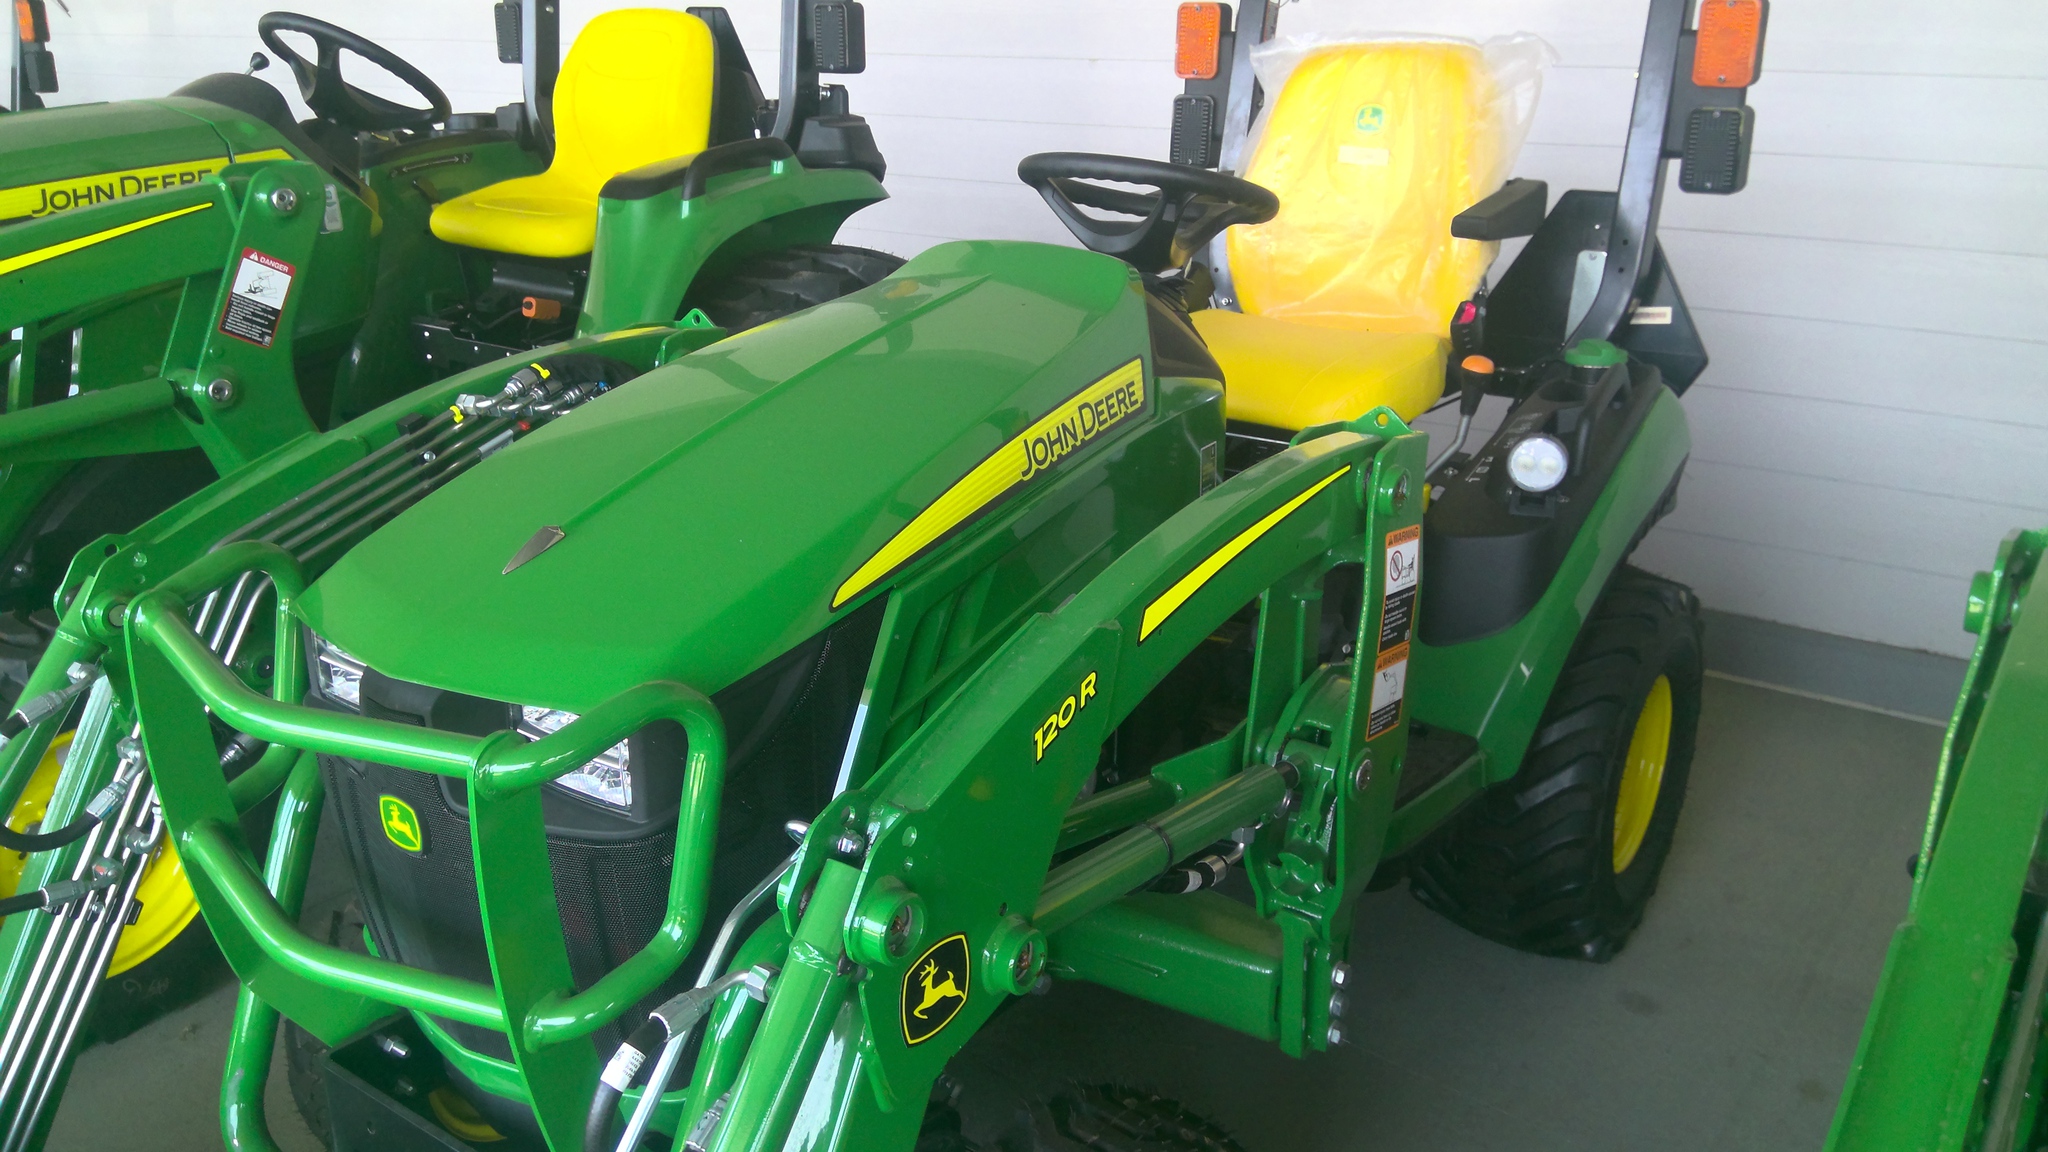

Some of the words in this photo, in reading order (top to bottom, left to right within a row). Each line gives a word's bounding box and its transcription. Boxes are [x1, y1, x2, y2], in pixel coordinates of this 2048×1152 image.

[31, 182, 115, 215] JOHN
[259, 256, 289, 273] DANGER
[1021, 416, 1078, 478] JOHN
[1078, 380, 1138, 437] DEERE
[1393, 526, 1419, 544] WARNING
[1034, 695, 1076, 762] 120
[1080, 671, 1096, 709] R
